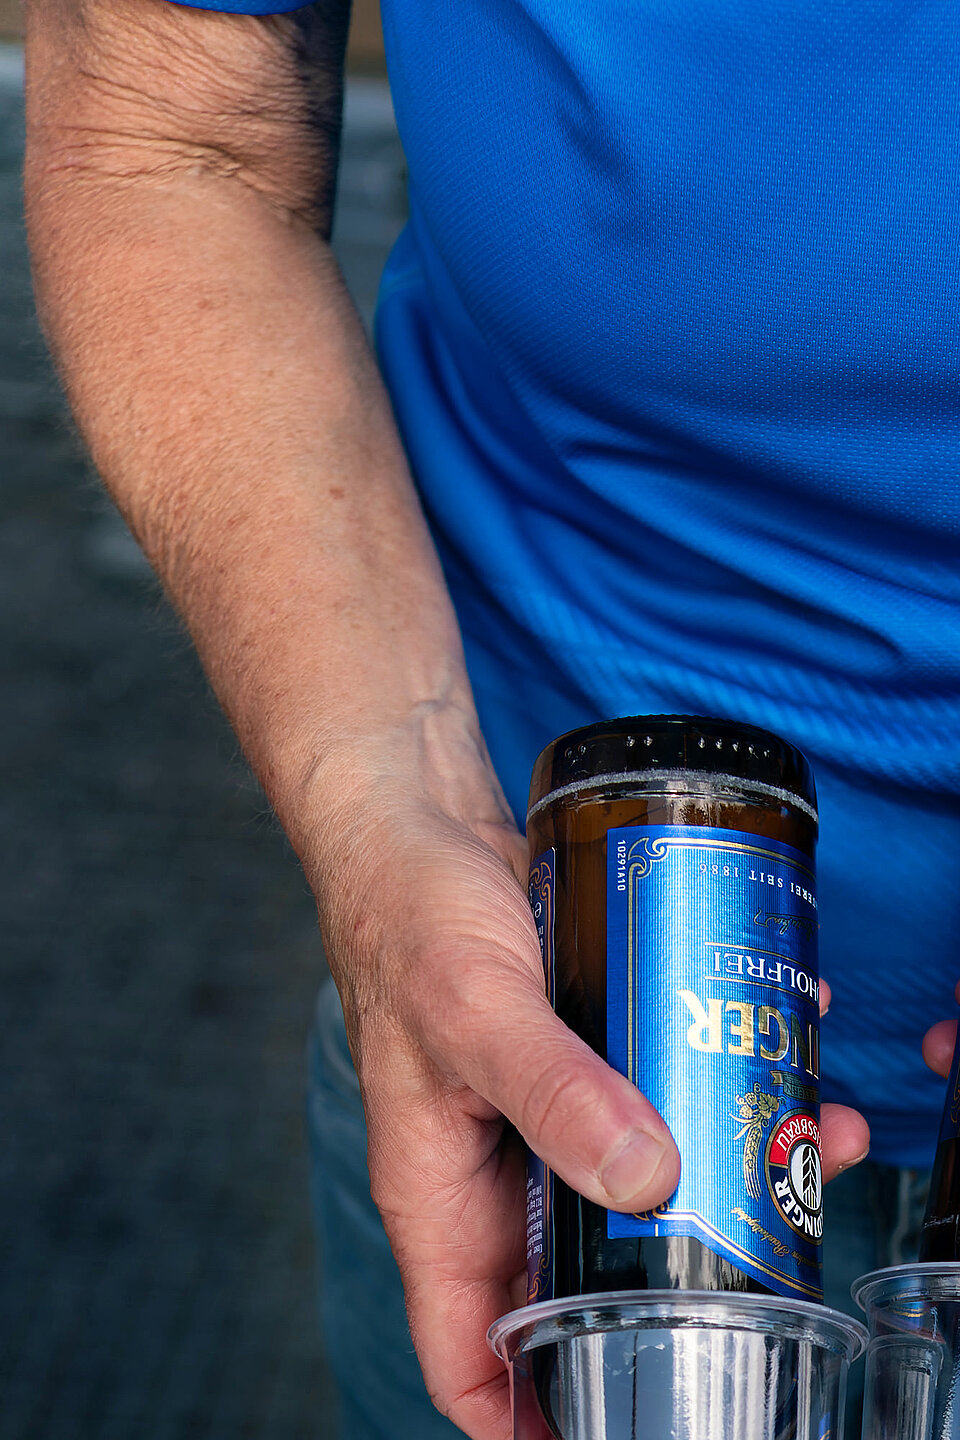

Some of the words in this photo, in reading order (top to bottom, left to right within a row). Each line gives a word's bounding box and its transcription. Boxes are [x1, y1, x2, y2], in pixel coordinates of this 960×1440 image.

[617, 840, 626, 891] 10291A10
[698, 863, 739, 878] 1886
[748, 870, 783, 888] SEIT
[713, 951, 819, 1002] HOLFREI
[775, 1118, 822, 1158] ISSBRÄU
[774, 1176, 823, 1238] DINGER
